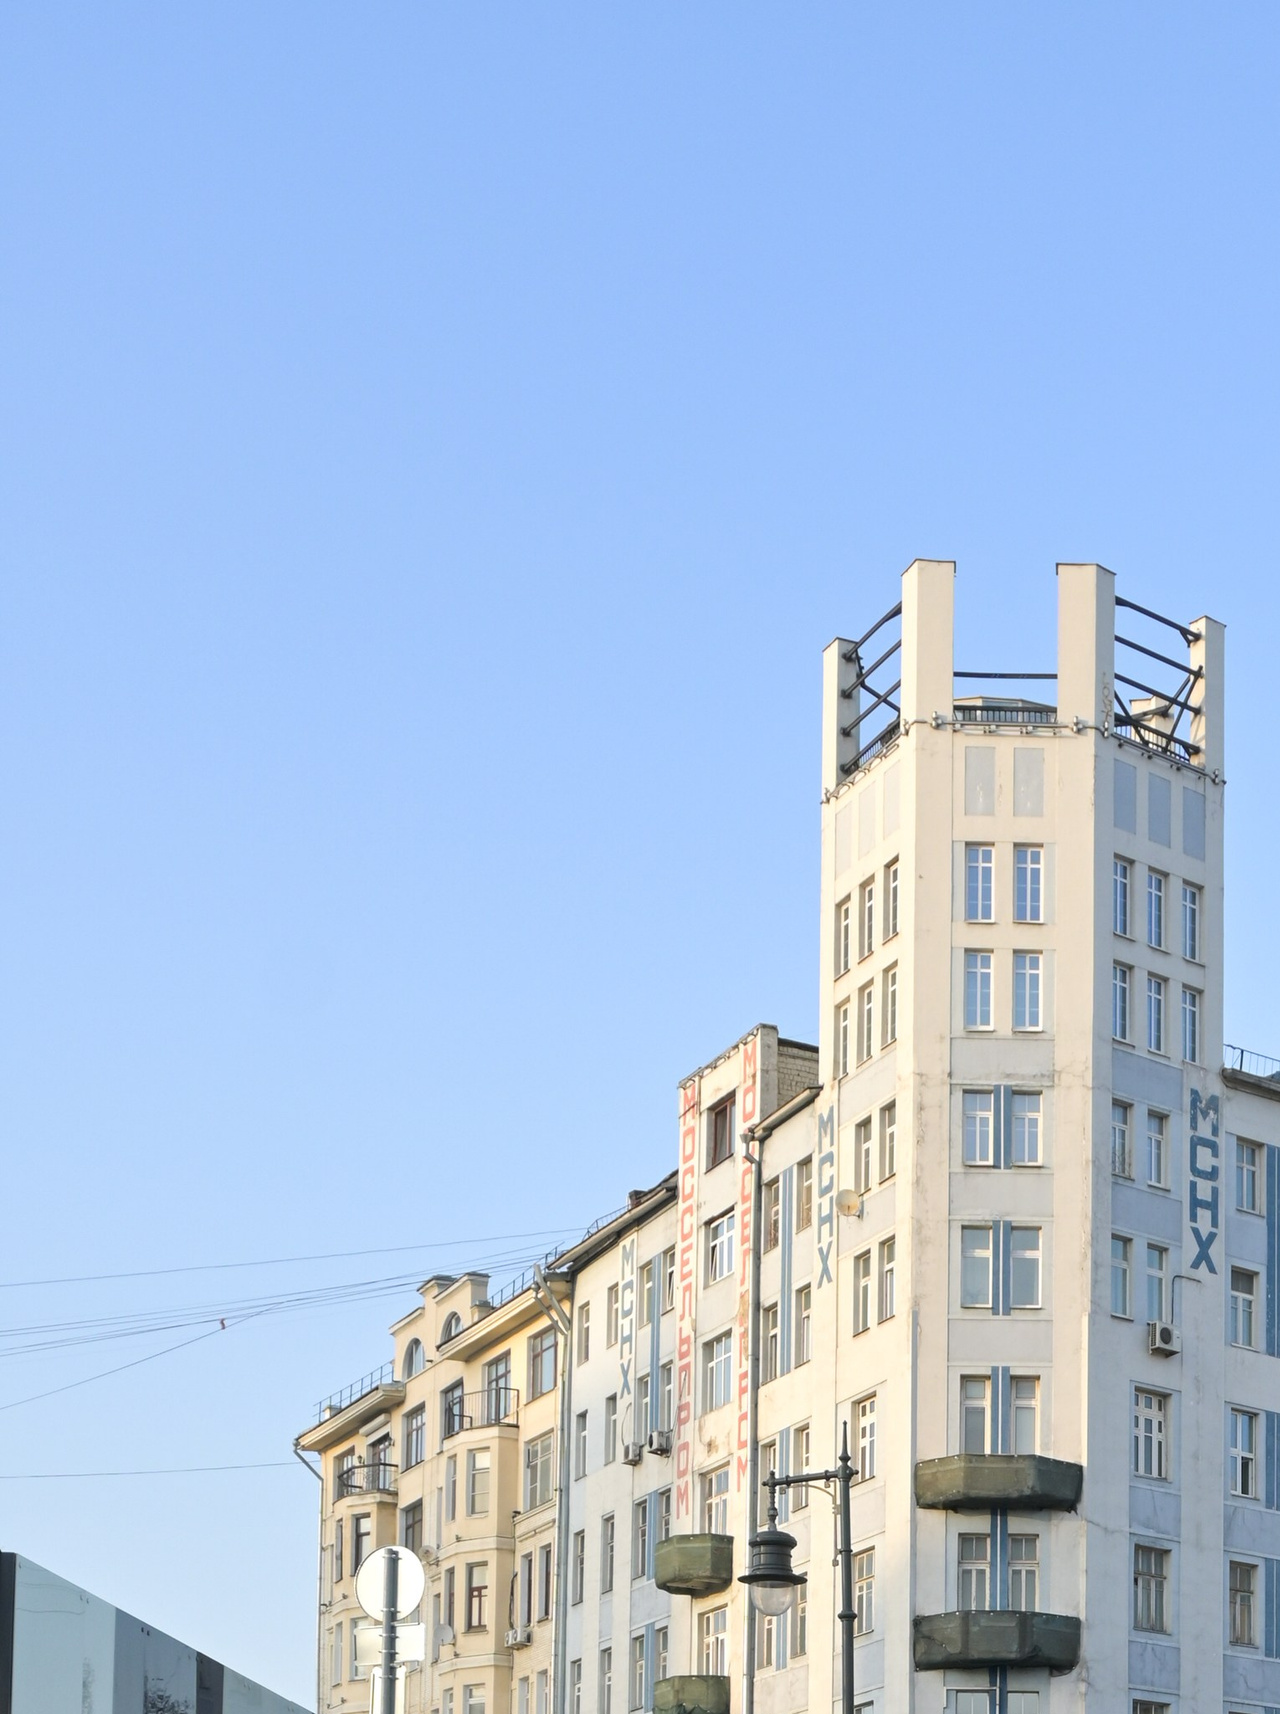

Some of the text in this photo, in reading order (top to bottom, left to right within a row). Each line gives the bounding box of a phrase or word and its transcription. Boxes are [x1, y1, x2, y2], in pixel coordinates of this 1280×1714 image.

[817, 1104, 835, 1290] МСНХ
[1189, 1087, 1220, 1275] МСНХ
[619, 1238, 636, 1399] МСНХ
[676, 1084, 696, 1519] МОССЕЛЬПРОМ
